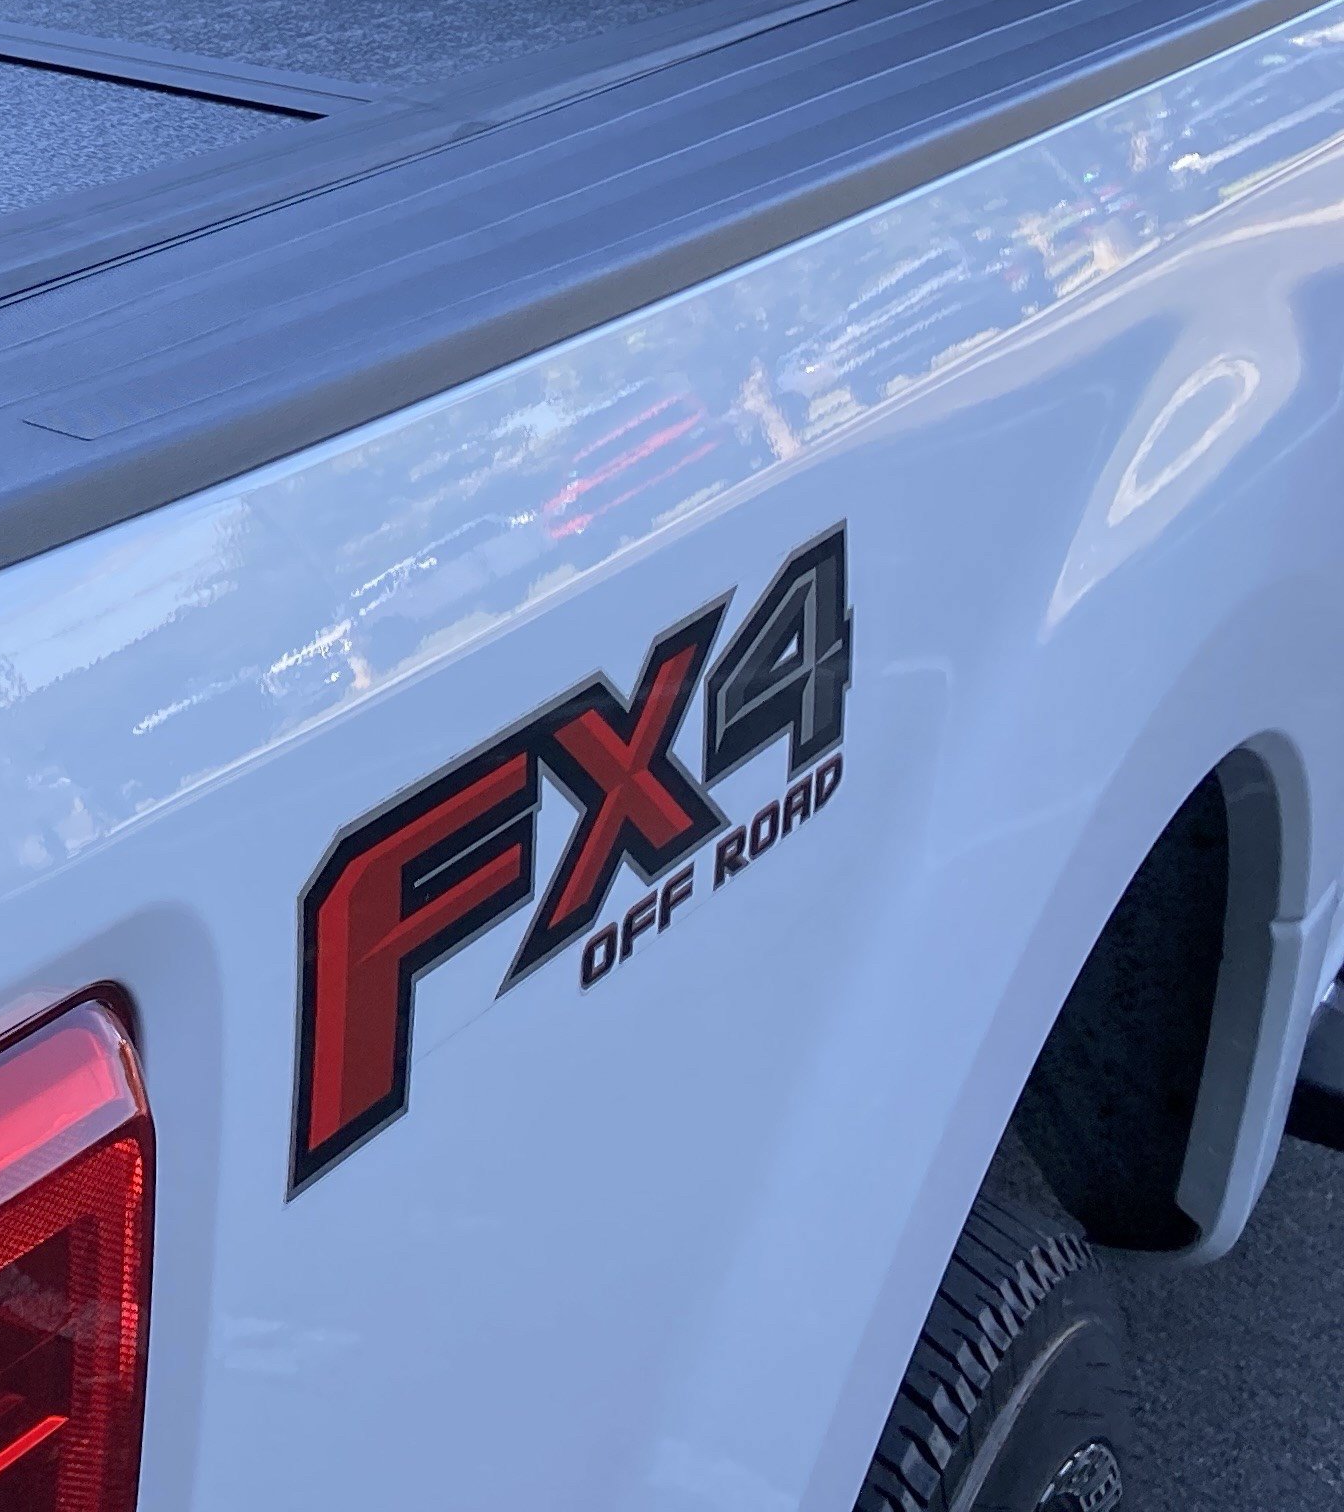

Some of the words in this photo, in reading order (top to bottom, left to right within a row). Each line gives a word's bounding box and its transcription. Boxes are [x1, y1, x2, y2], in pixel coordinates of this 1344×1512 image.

[283, 518, 854, 1204] FX4
[580, 860, 695, 991] OFF
[712, 751, 844, 892] ROAD
